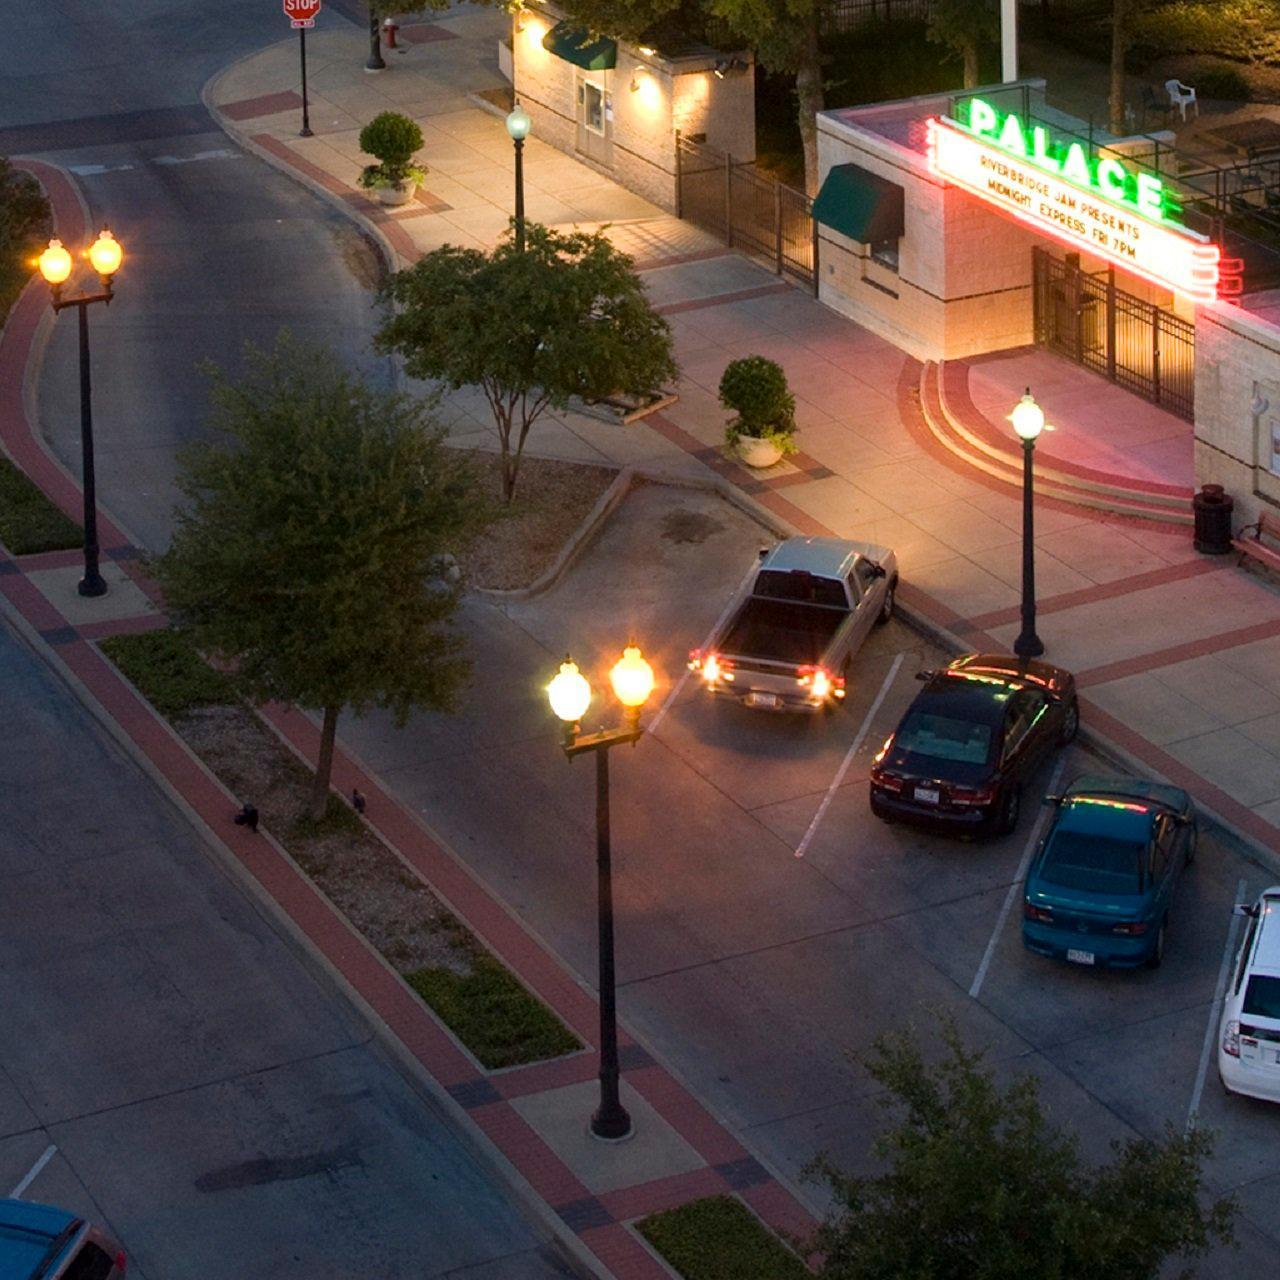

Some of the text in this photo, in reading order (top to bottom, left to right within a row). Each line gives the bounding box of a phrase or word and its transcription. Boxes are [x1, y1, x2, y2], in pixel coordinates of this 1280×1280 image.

[971, 97, 1163, 220] PALACE
[987, 178, 1136, 259] MIDNIGHT EXPRESS FRI 7PM
[1054, 191, 1076, 210] JAM
[1080, 202, 1140, 240] PRESENTS
